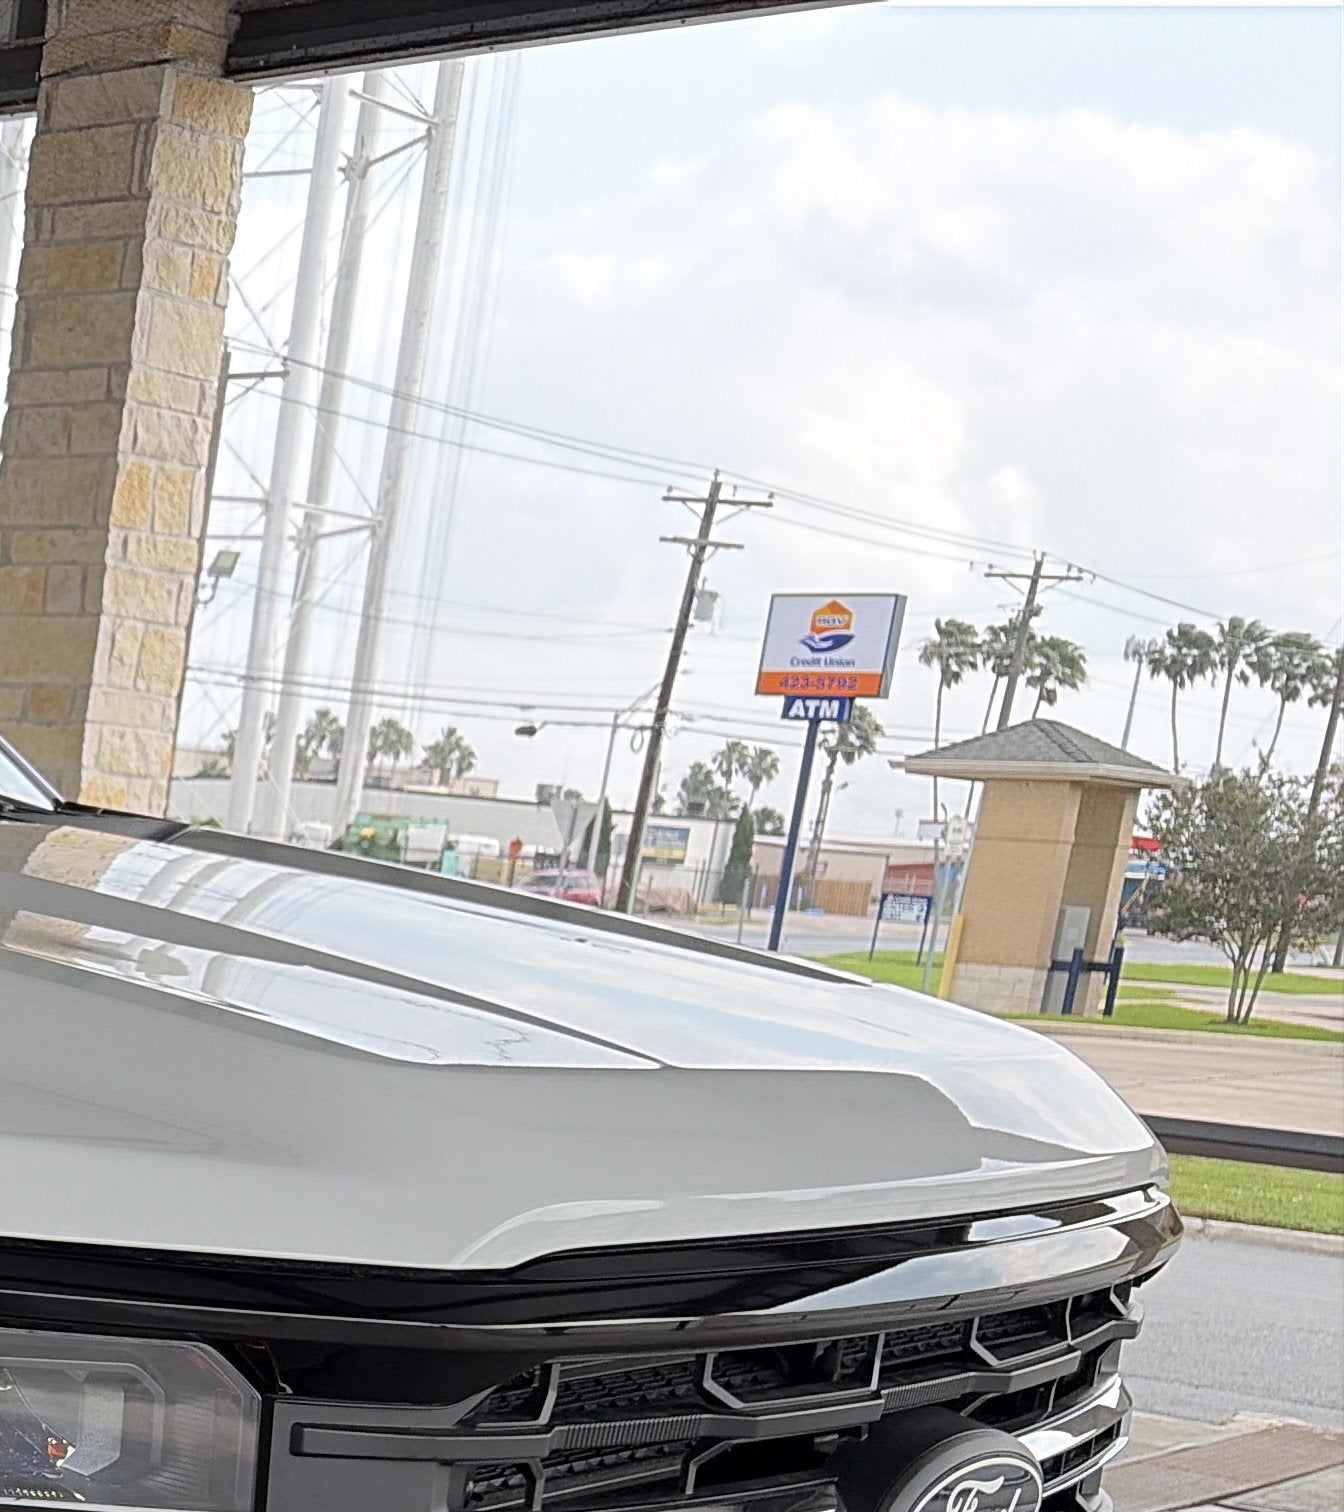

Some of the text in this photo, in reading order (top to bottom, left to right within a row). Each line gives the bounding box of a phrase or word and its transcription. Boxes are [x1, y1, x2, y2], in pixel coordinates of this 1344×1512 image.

[789, 655, 856, 668] Credit Union
[788, 699, 840, 719] ATM
